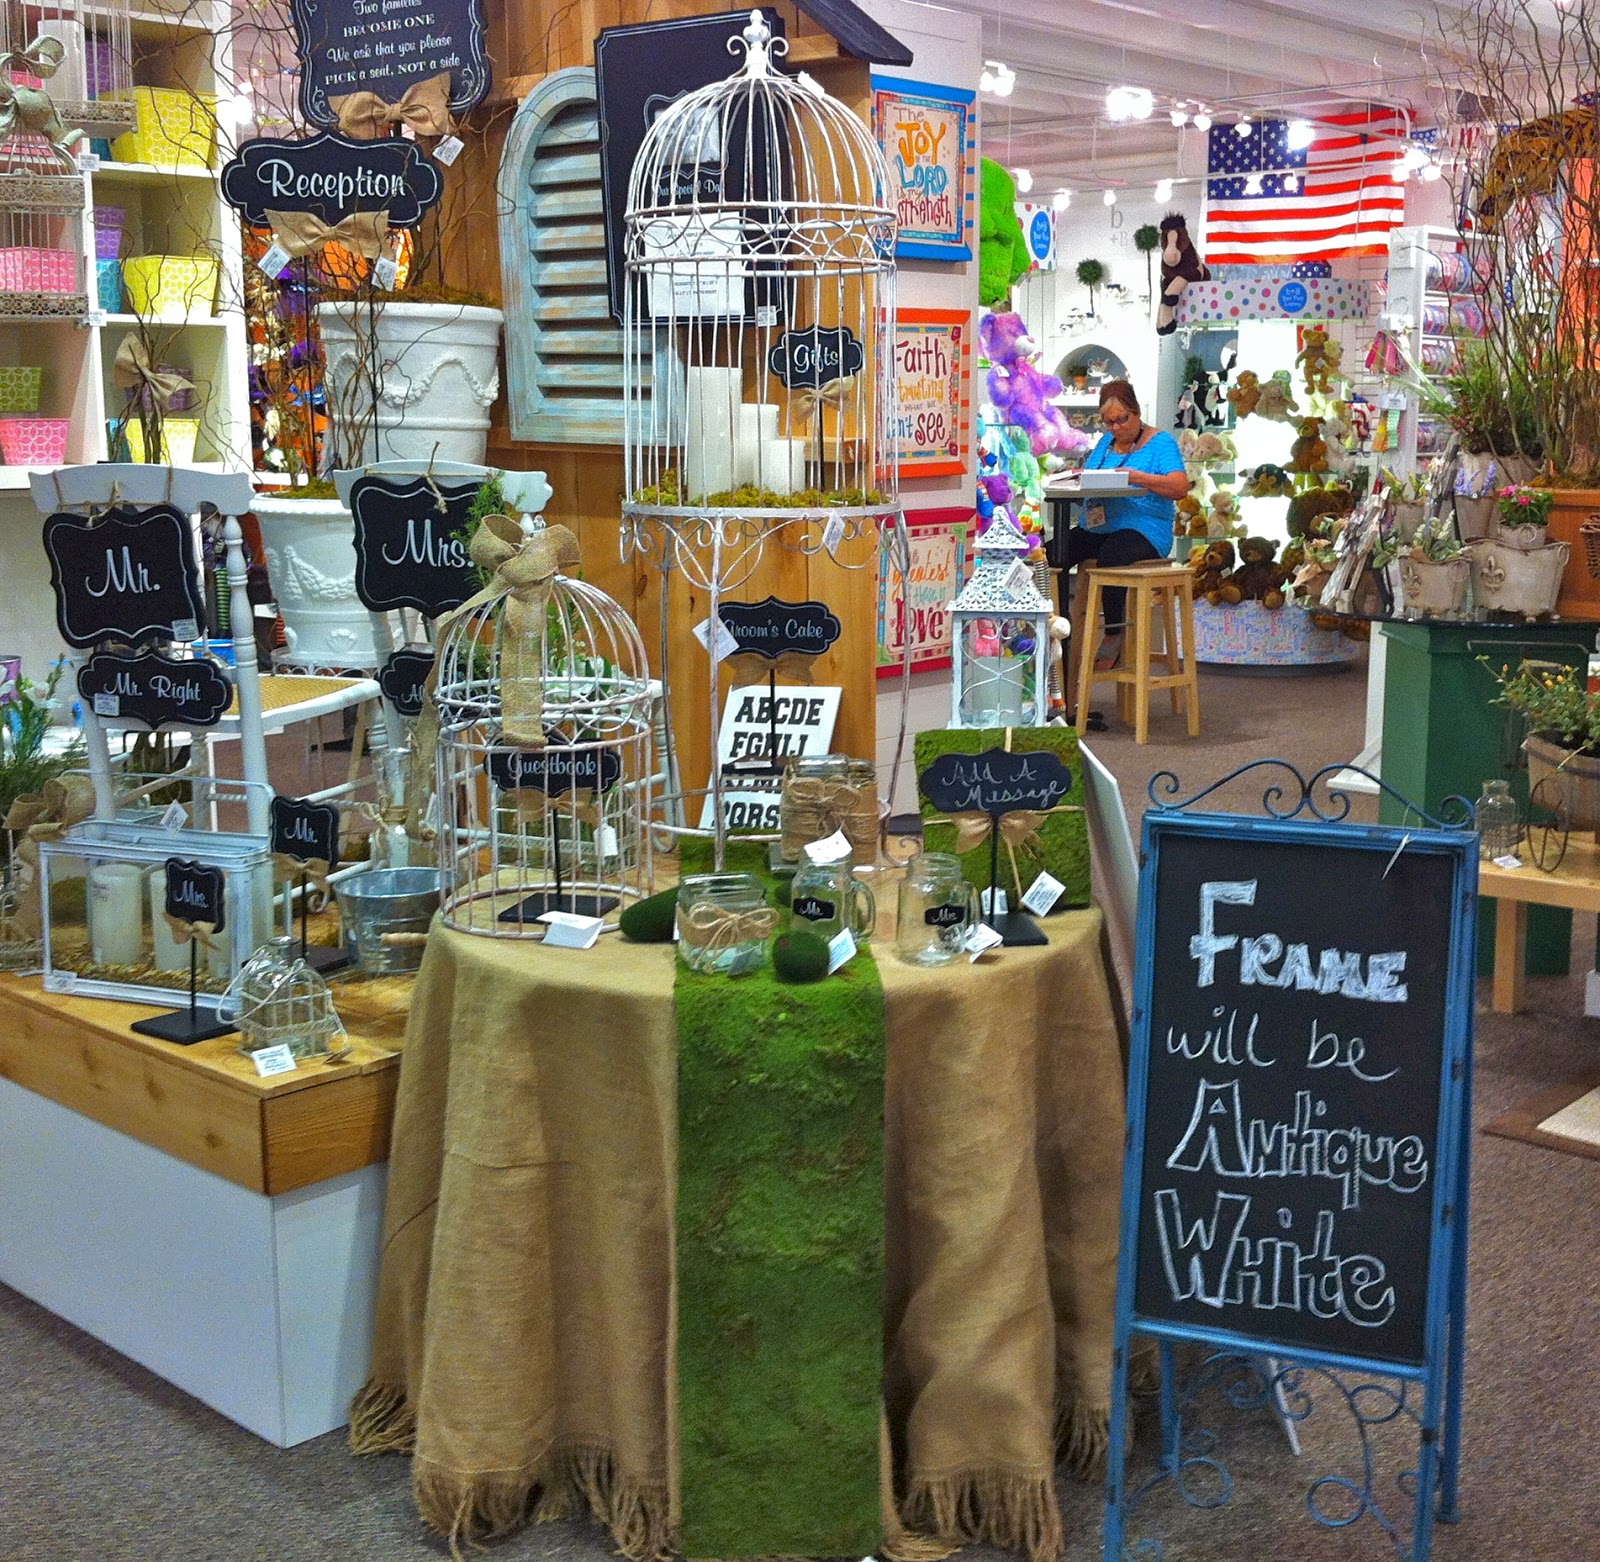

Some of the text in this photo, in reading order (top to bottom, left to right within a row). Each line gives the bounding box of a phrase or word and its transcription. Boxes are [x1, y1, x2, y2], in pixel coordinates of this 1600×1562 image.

[353, 0, 378, 15] Two
[343, 13, 435, 37] BECOME ONE
[326, 34, 452, 63] We ask that you please
[325, 69, 356, 85] PICK
[359, 70, 366, 80] a
[398, 60, 426, 75] NOT
[429, 59, 437, 70] a
[440, 52, 460, 67] side
[893, 107, 924, 122] The
[257, 158, 406, 209] Reception
[895, 154, 948, 196] LORD
[794, 343, 839, 373] Gifts
[382, 519, 475, 568] Mrs.
[85, 545, 161, 597] Mr.
[892, 549, 950, 603] geatest
[785, 618, 824, 639] Cake
[104, 672, 143, 697] Mr.
[150, 675, 201, 706] Right
[734, 696, 825, 726] ABCDE
[507, 752, 597, 780] Guestbook
[942, 758, 1037, 787] Add A
[955, 780, 1067, 811] Message
[1166, 1005, 1399, 1082] will be
